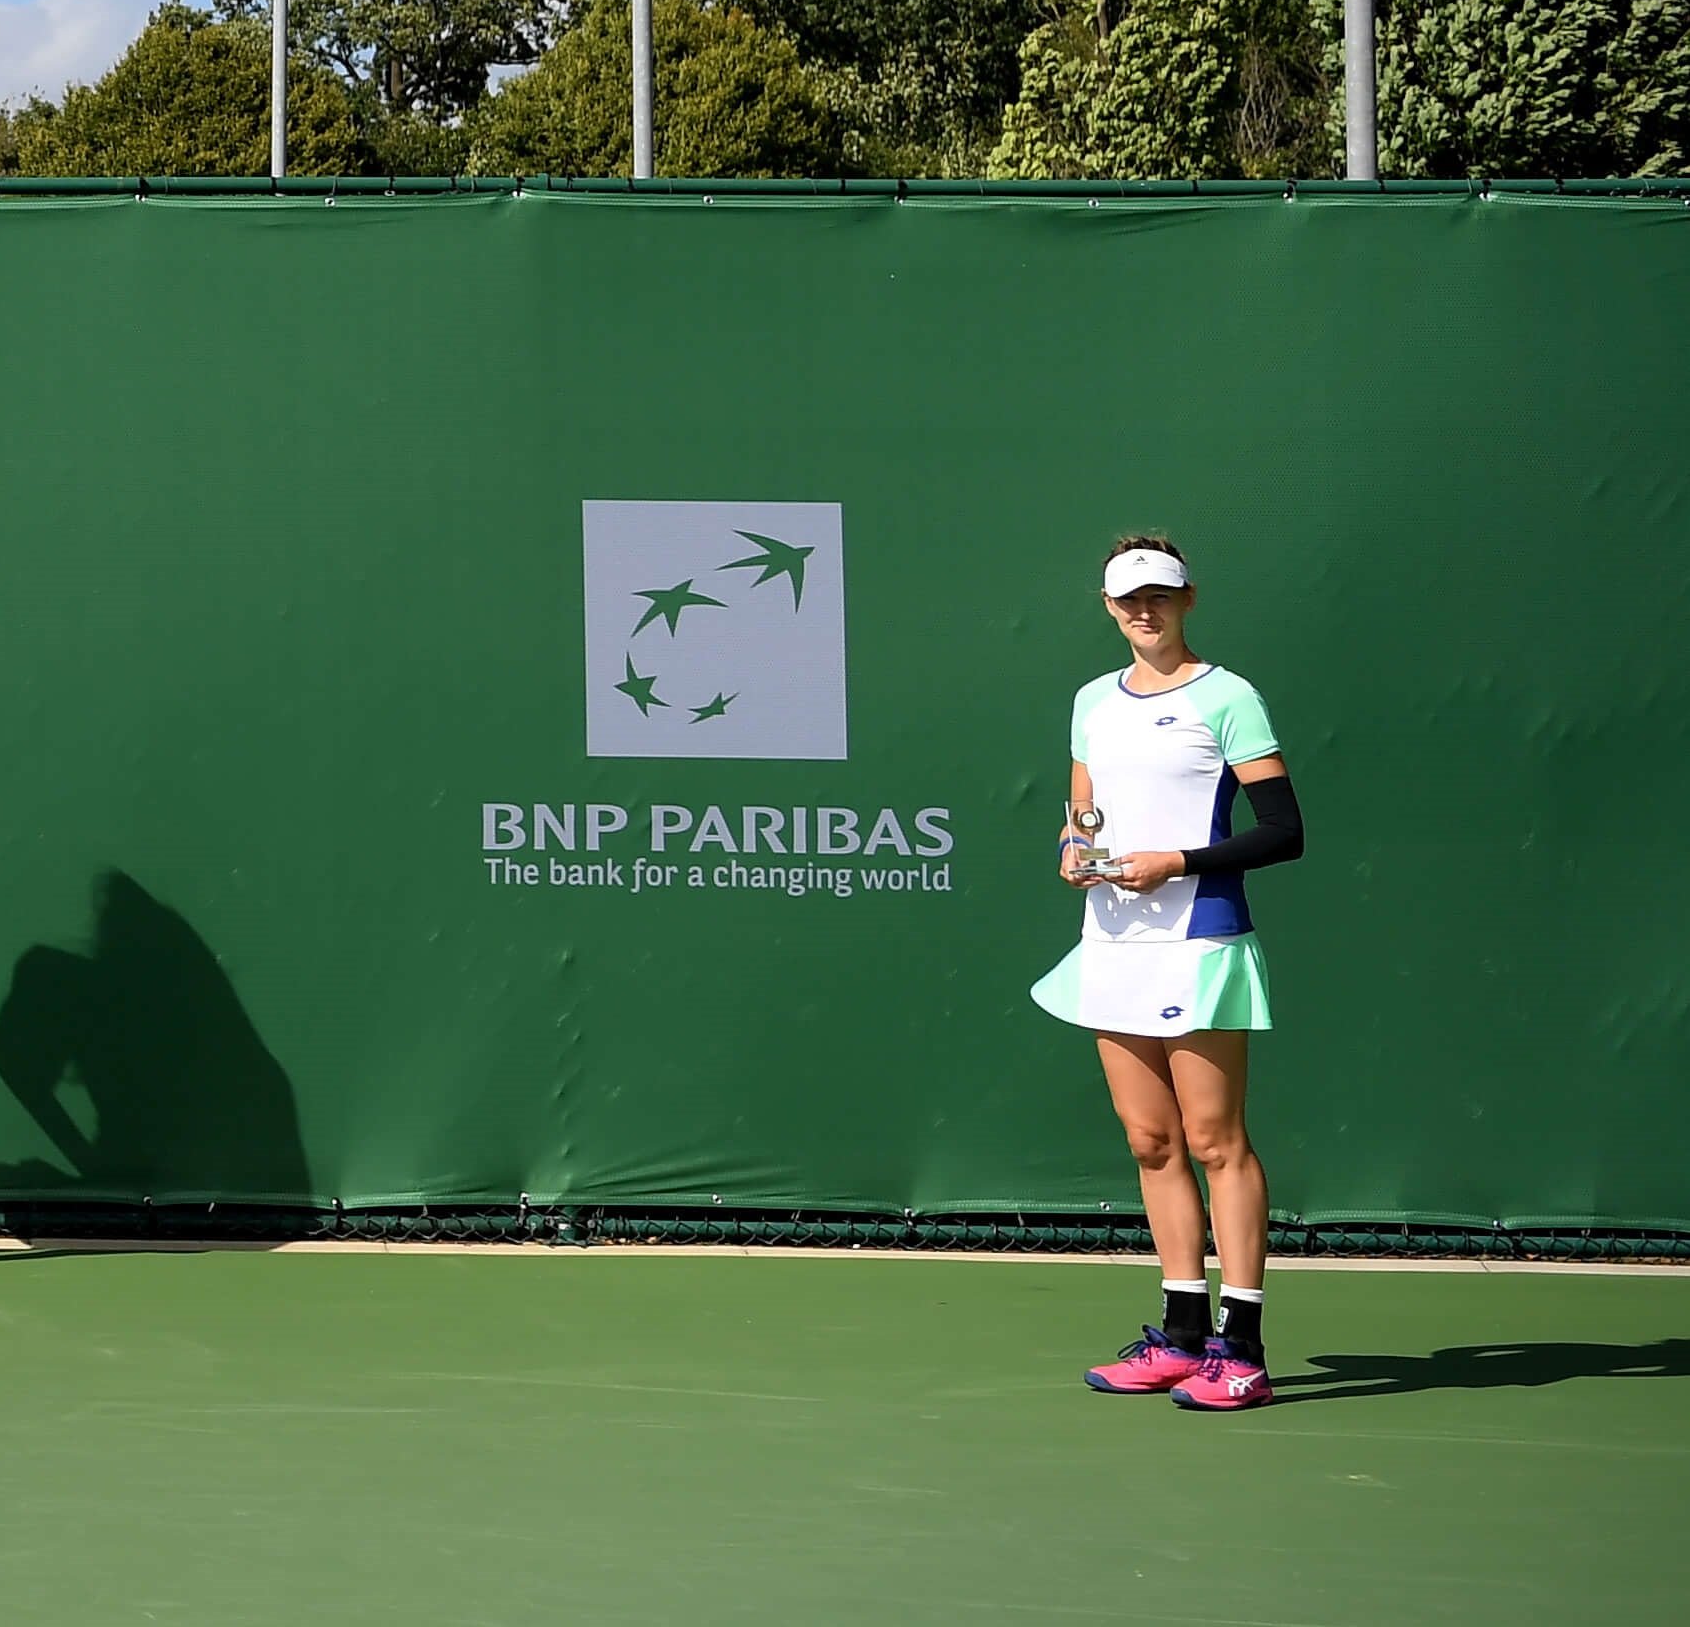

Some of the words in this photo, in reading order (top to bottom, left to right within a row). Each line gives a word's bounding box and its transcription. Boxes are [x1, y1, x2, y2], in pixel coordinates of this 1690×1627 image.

[482, 803, 628, 851] BNP
[651, 803, 954, 857] PARIBAS
[484, 858, 540, 886] The
[549, 859, 623, 886] bank
[631, 858, 678, 893] for
[687, 867, 705, 887] a
[713, 862, 853, 897] changing
[861, 864, 952, 892] world
